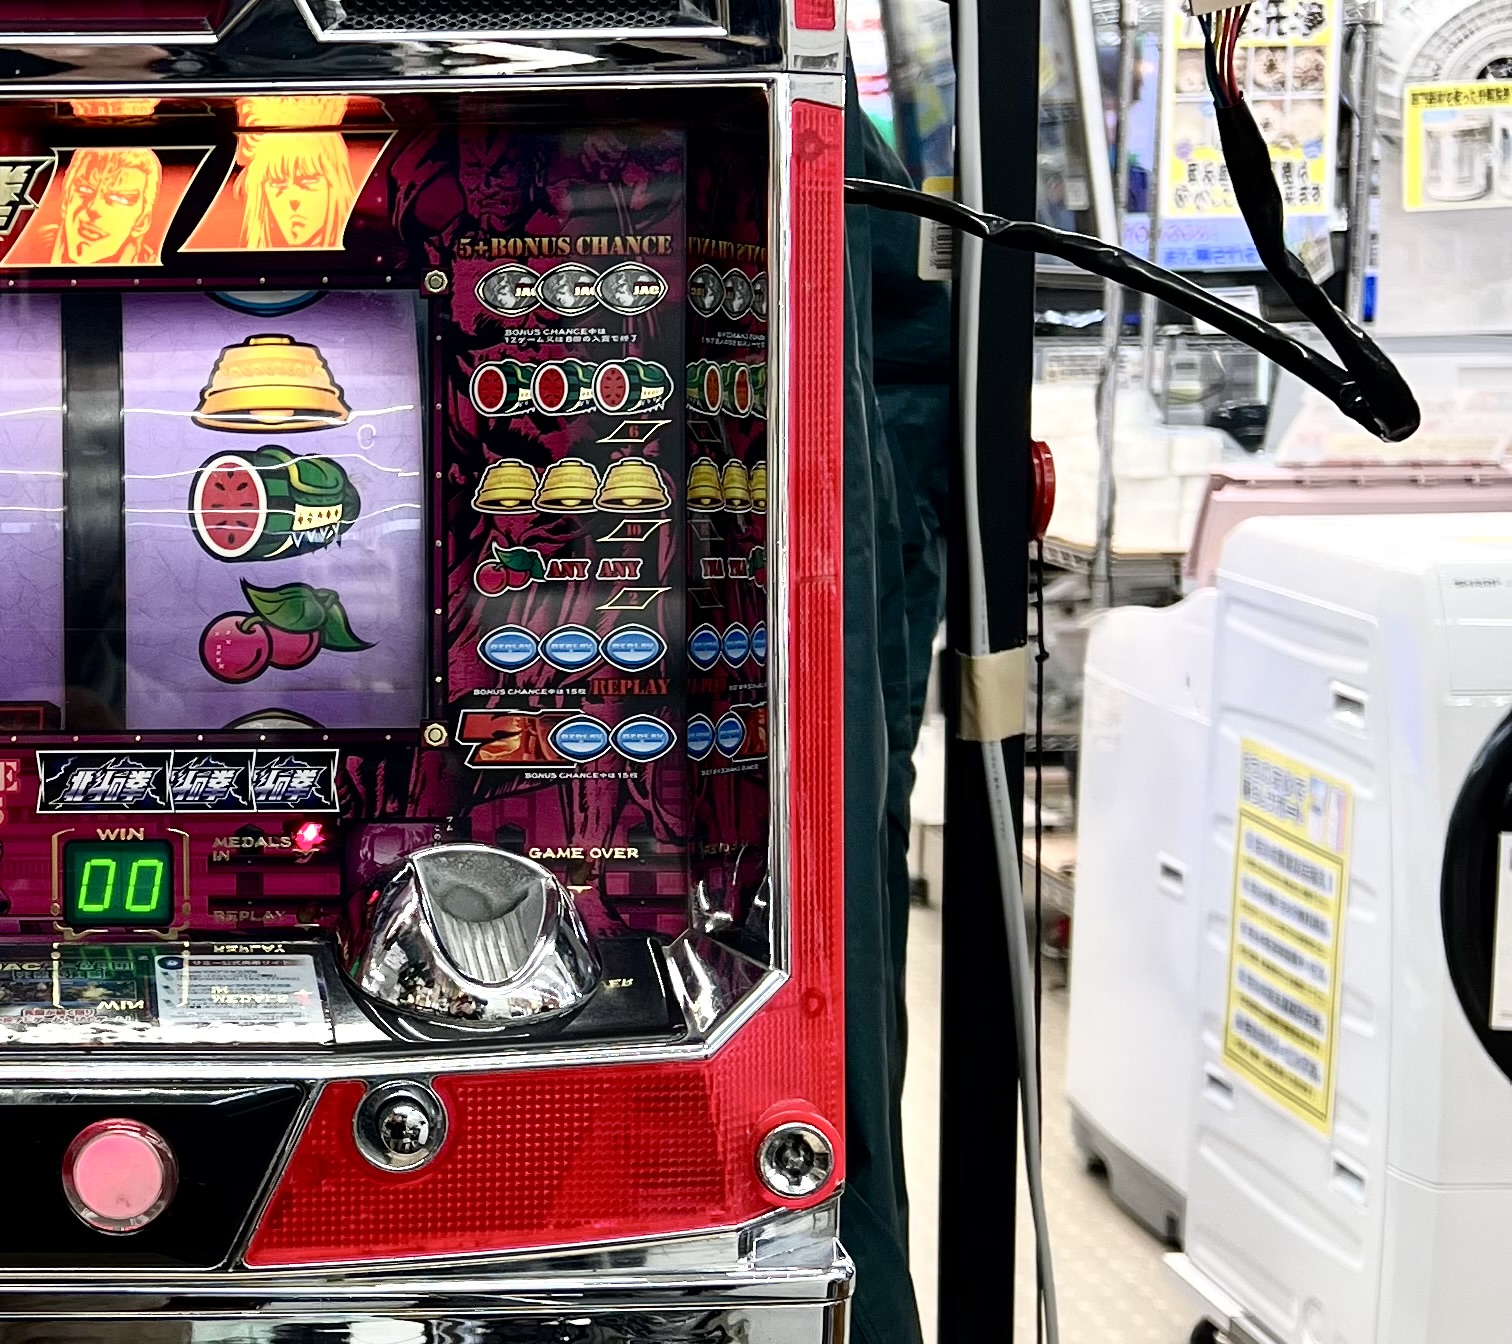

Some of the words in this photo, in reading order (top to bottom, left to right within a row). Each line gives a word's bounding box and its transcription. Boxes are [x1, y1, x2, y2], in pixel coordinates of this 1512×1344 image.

[575, 235, 673, 257] CHANCE
[632, 285, 660, 296] JAC
[547, 560, 589, 578] ANY
[600, 560, 643, 578] ANY
[590, 679, 670, 696] REPLAY
[96, 827, 146, 841] WIN
[212, 836, 292, 849] MEDALS
[212, 849, 231, 862] IN
[528, 847, 586, 859] GAME
[589, 847, 640, 859] OVER
[77, 858, 165, 913] 00
[212, 909, 287, 922] REPLAY
